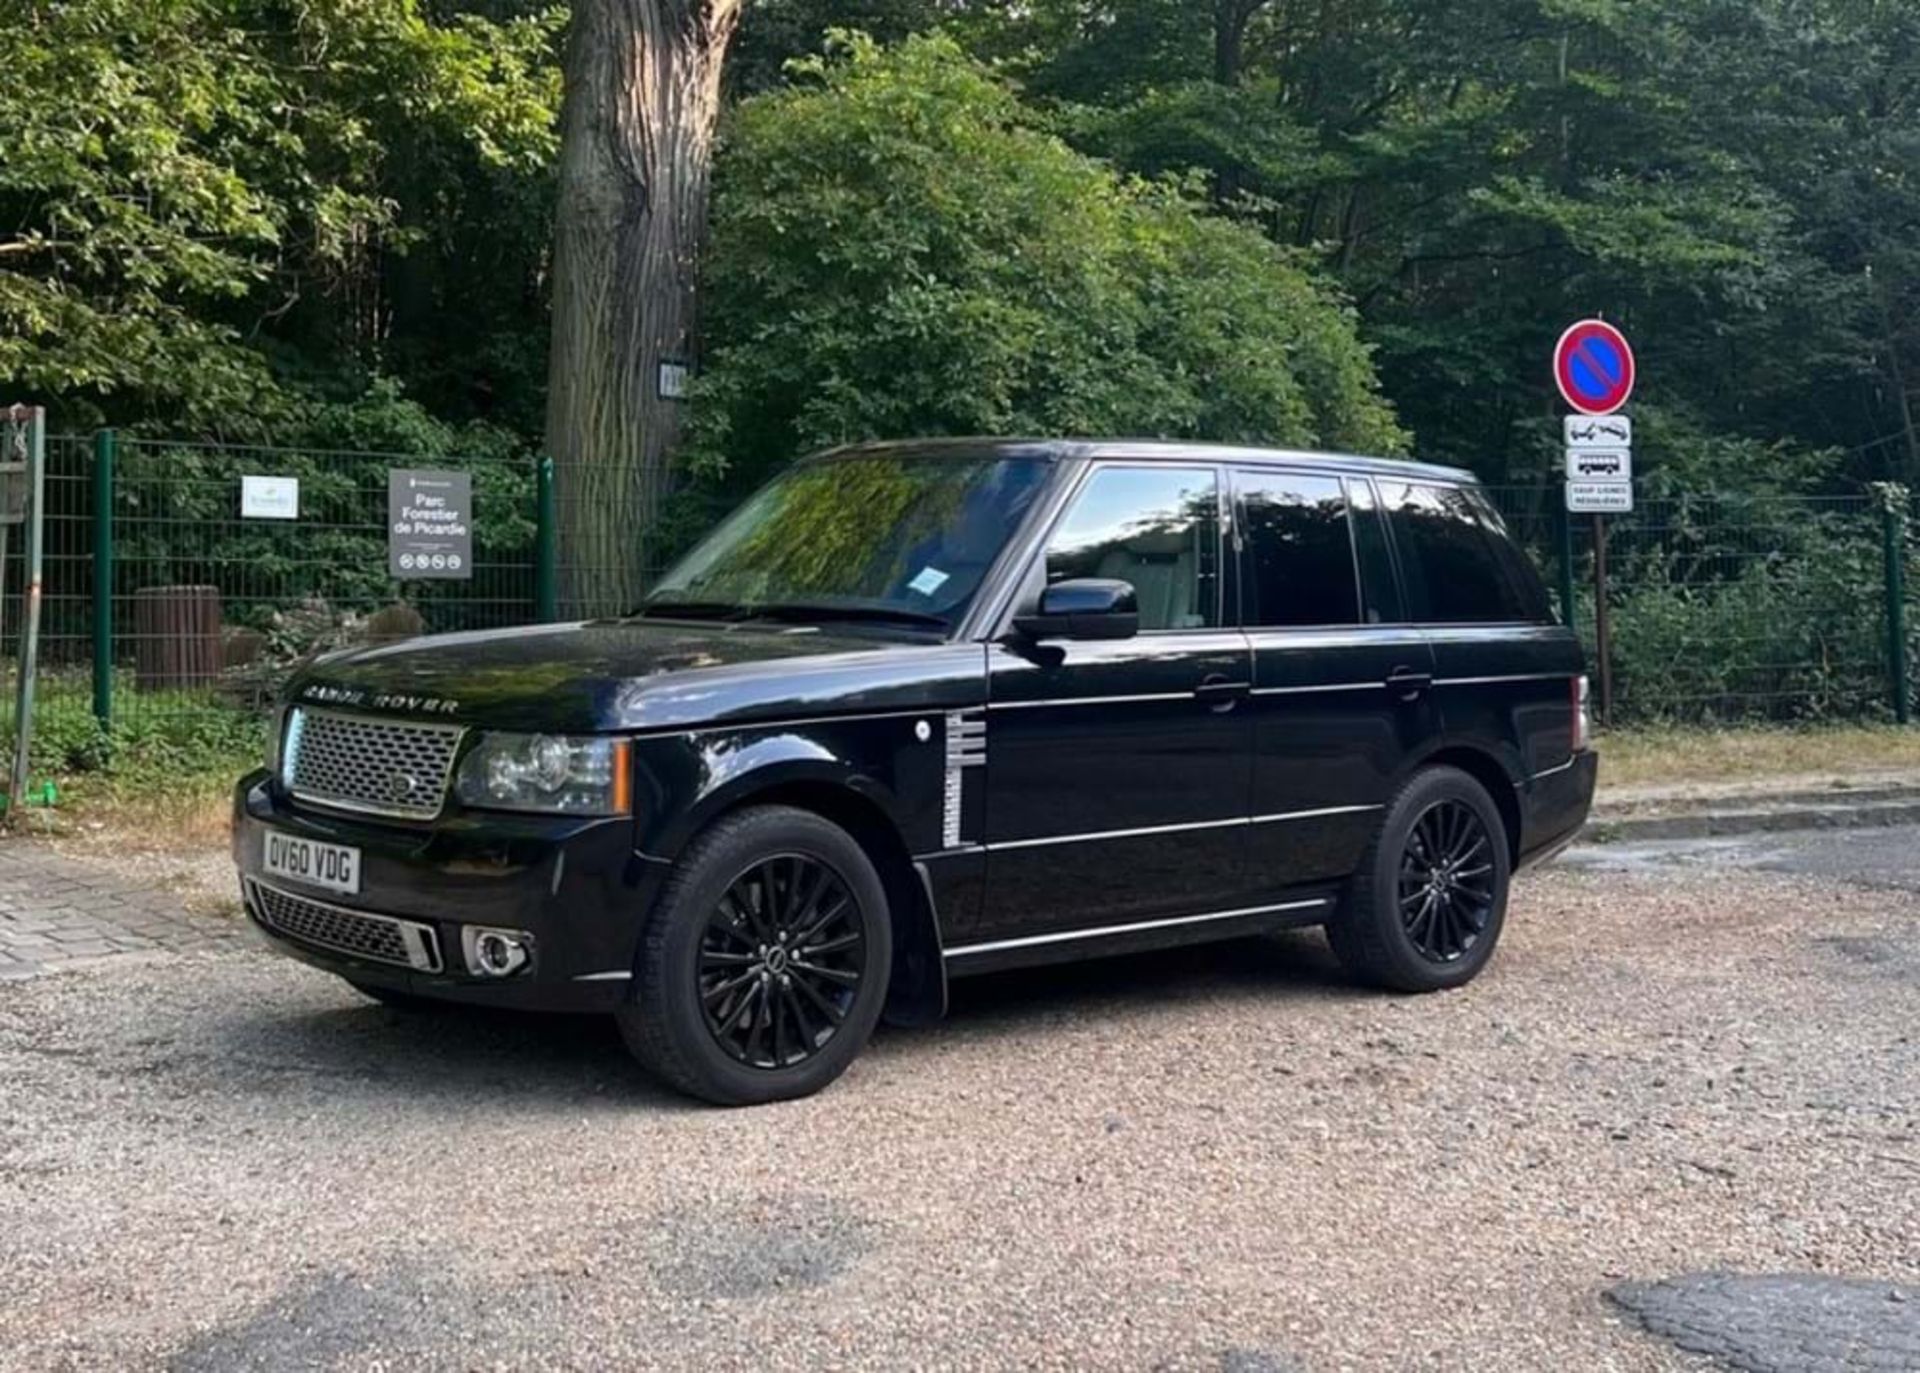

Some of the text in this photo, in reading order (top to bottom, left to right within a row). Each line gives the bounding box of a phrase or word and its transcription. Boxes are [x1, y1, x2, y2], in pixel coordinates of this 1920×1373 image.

[416, 493, 446, 507] Parc
[402, 506, 458, 520] Forestier
[394, 521, 466, 536] de Picardie
[373, 695, 459, 713] ROVER
[270, 836, 350, 883] OV60 VDG
